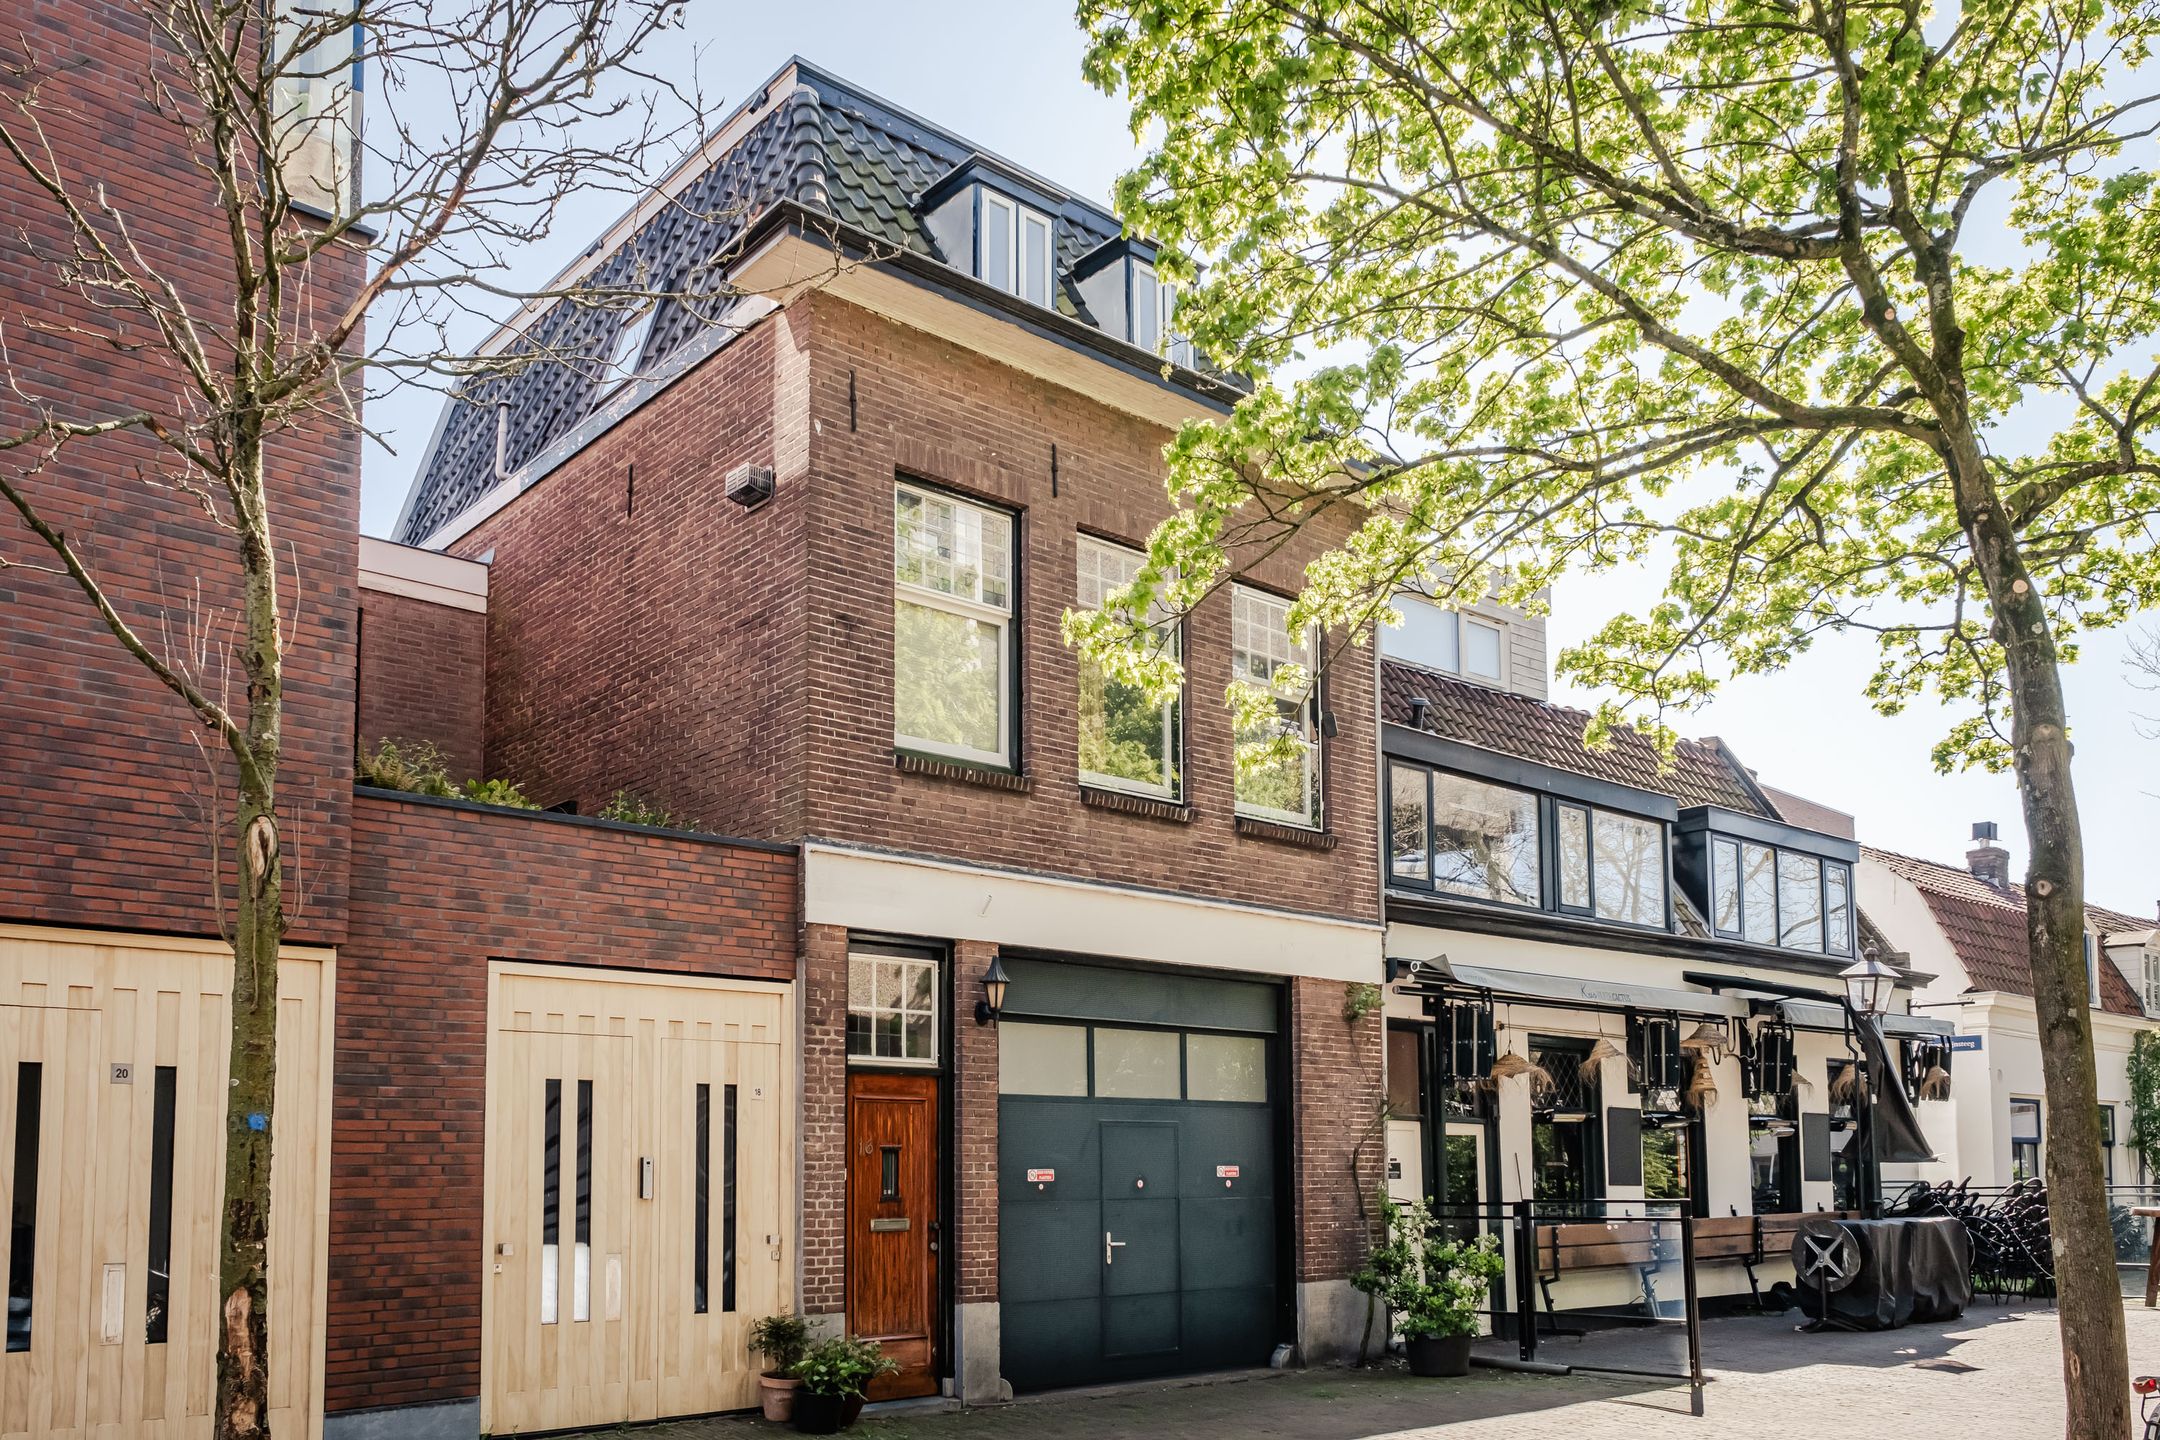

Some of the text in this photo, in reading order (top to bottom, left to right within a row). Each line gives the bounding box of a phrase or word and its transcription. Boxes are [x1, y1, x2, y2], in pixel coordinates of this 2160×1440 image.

[116, 1068, 128, 1079] 20
[755, 1088, 761, 1096] 18
[859, 1135, 874, 1155] 16
